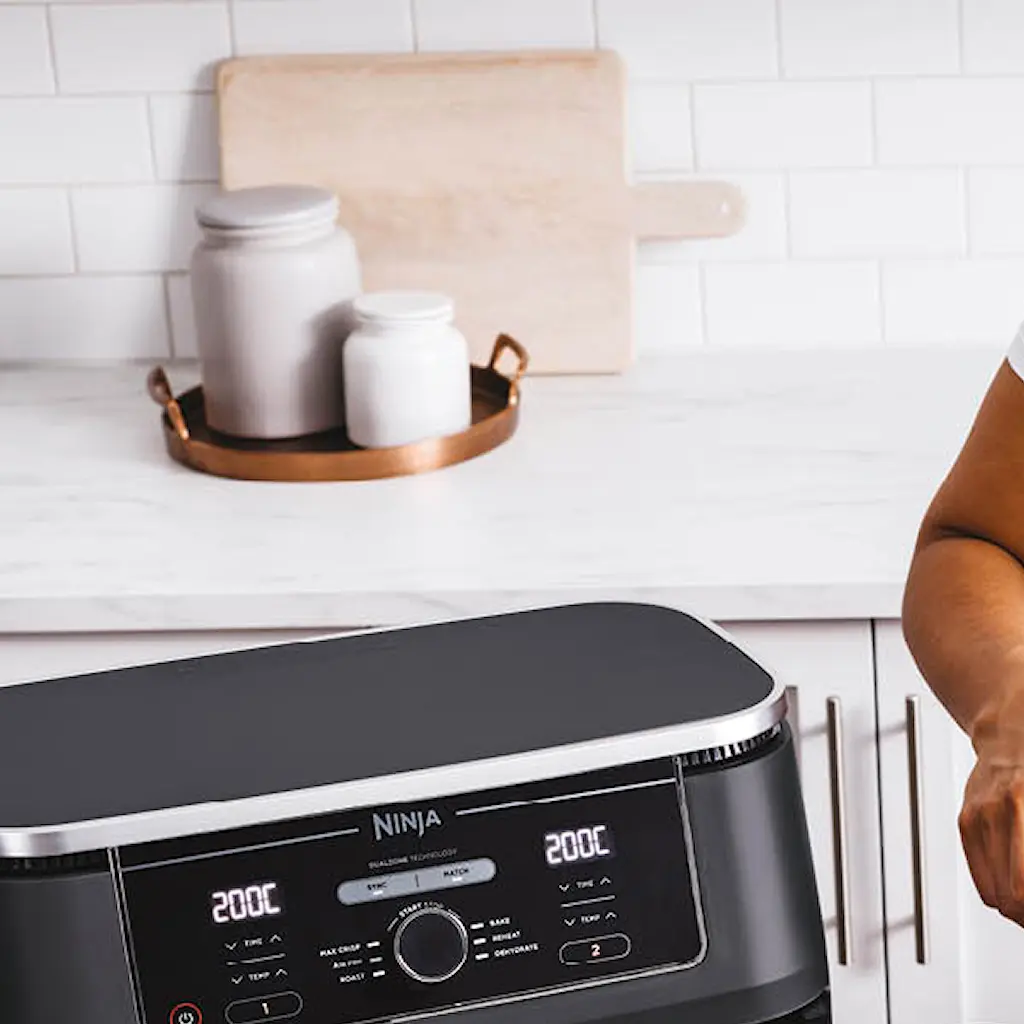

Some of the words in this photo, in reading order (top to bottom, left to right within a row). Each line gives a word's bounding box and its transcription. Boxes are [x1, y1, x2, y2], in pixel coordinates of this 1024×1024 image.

[372, 809, 442, 841] NINJA
[545, 825, 610, 865] 200C
[443, 868, 469, 877] MATCH
[212, 883, 280, 923] 200C
[591, 944, 600, 957] 2
[262, 1002, 269, 1015] 1
